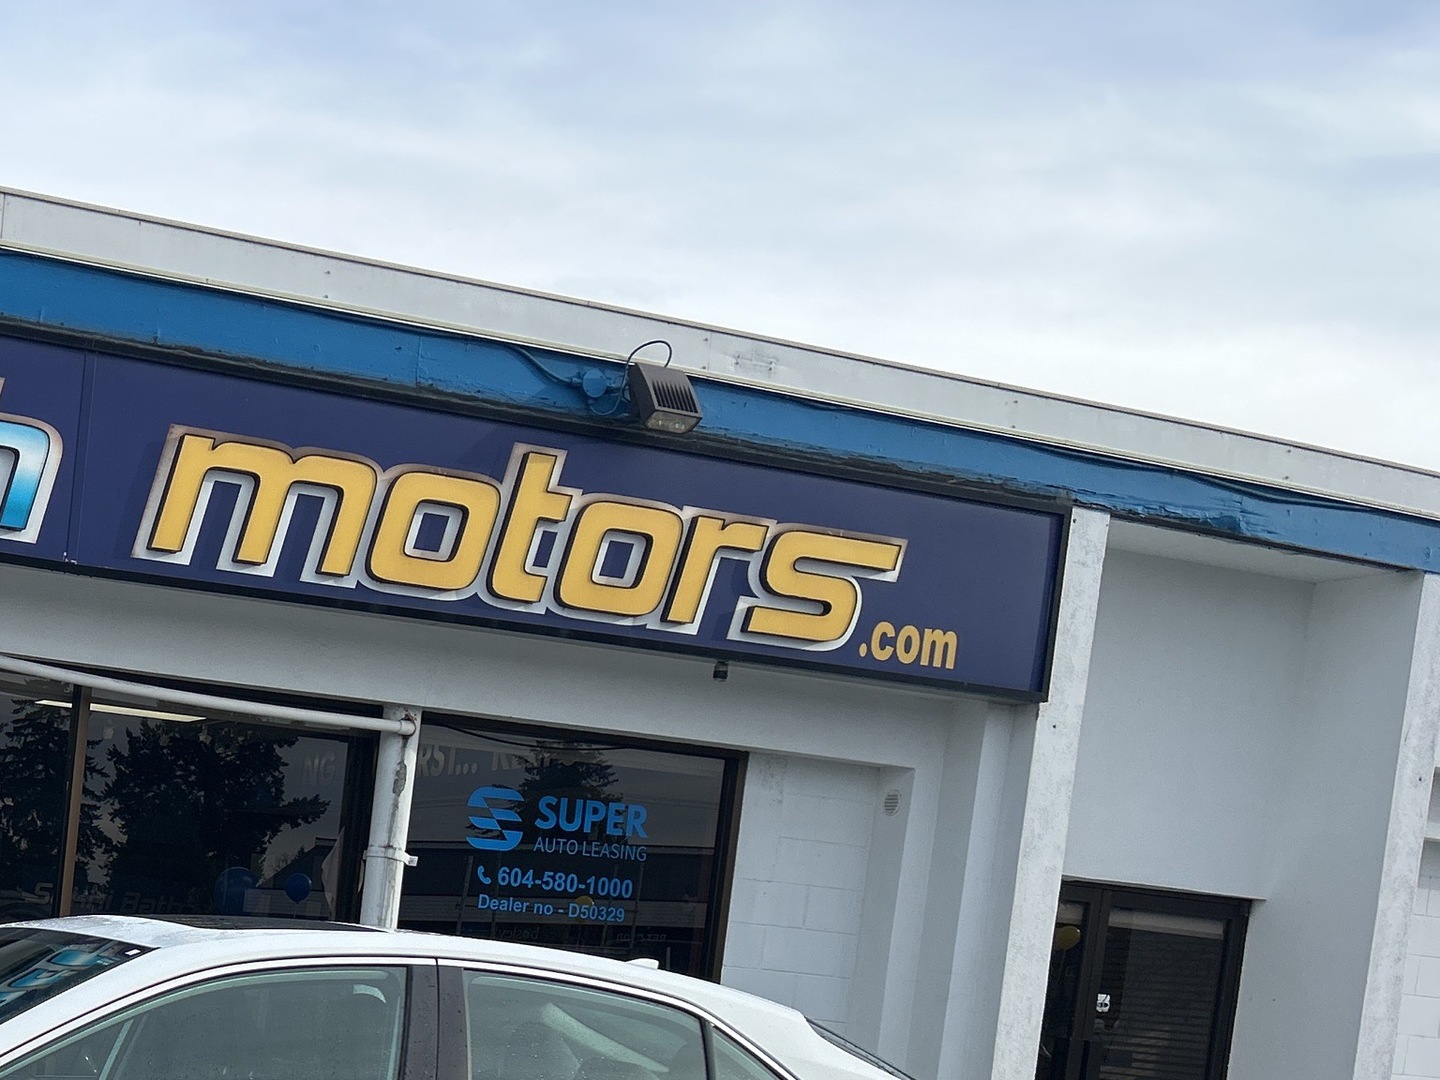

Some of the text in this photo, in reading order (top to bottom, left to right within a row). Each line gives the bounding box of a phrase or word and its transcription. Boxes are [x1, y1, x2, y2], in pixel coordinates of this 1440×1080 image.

[131, 424, 908, 652] motors
[859, 619, 958, 670] .com
[534, 796, 648, 839] SUPER
[533, 837, 647, 862] AUTO LEASING
[497, 867, 633, 898] 604-580-1000
[478, 895, 529, 914] Dealer
[533, 902, 553, 916] no
[568, 903, 625, 923] D50329
